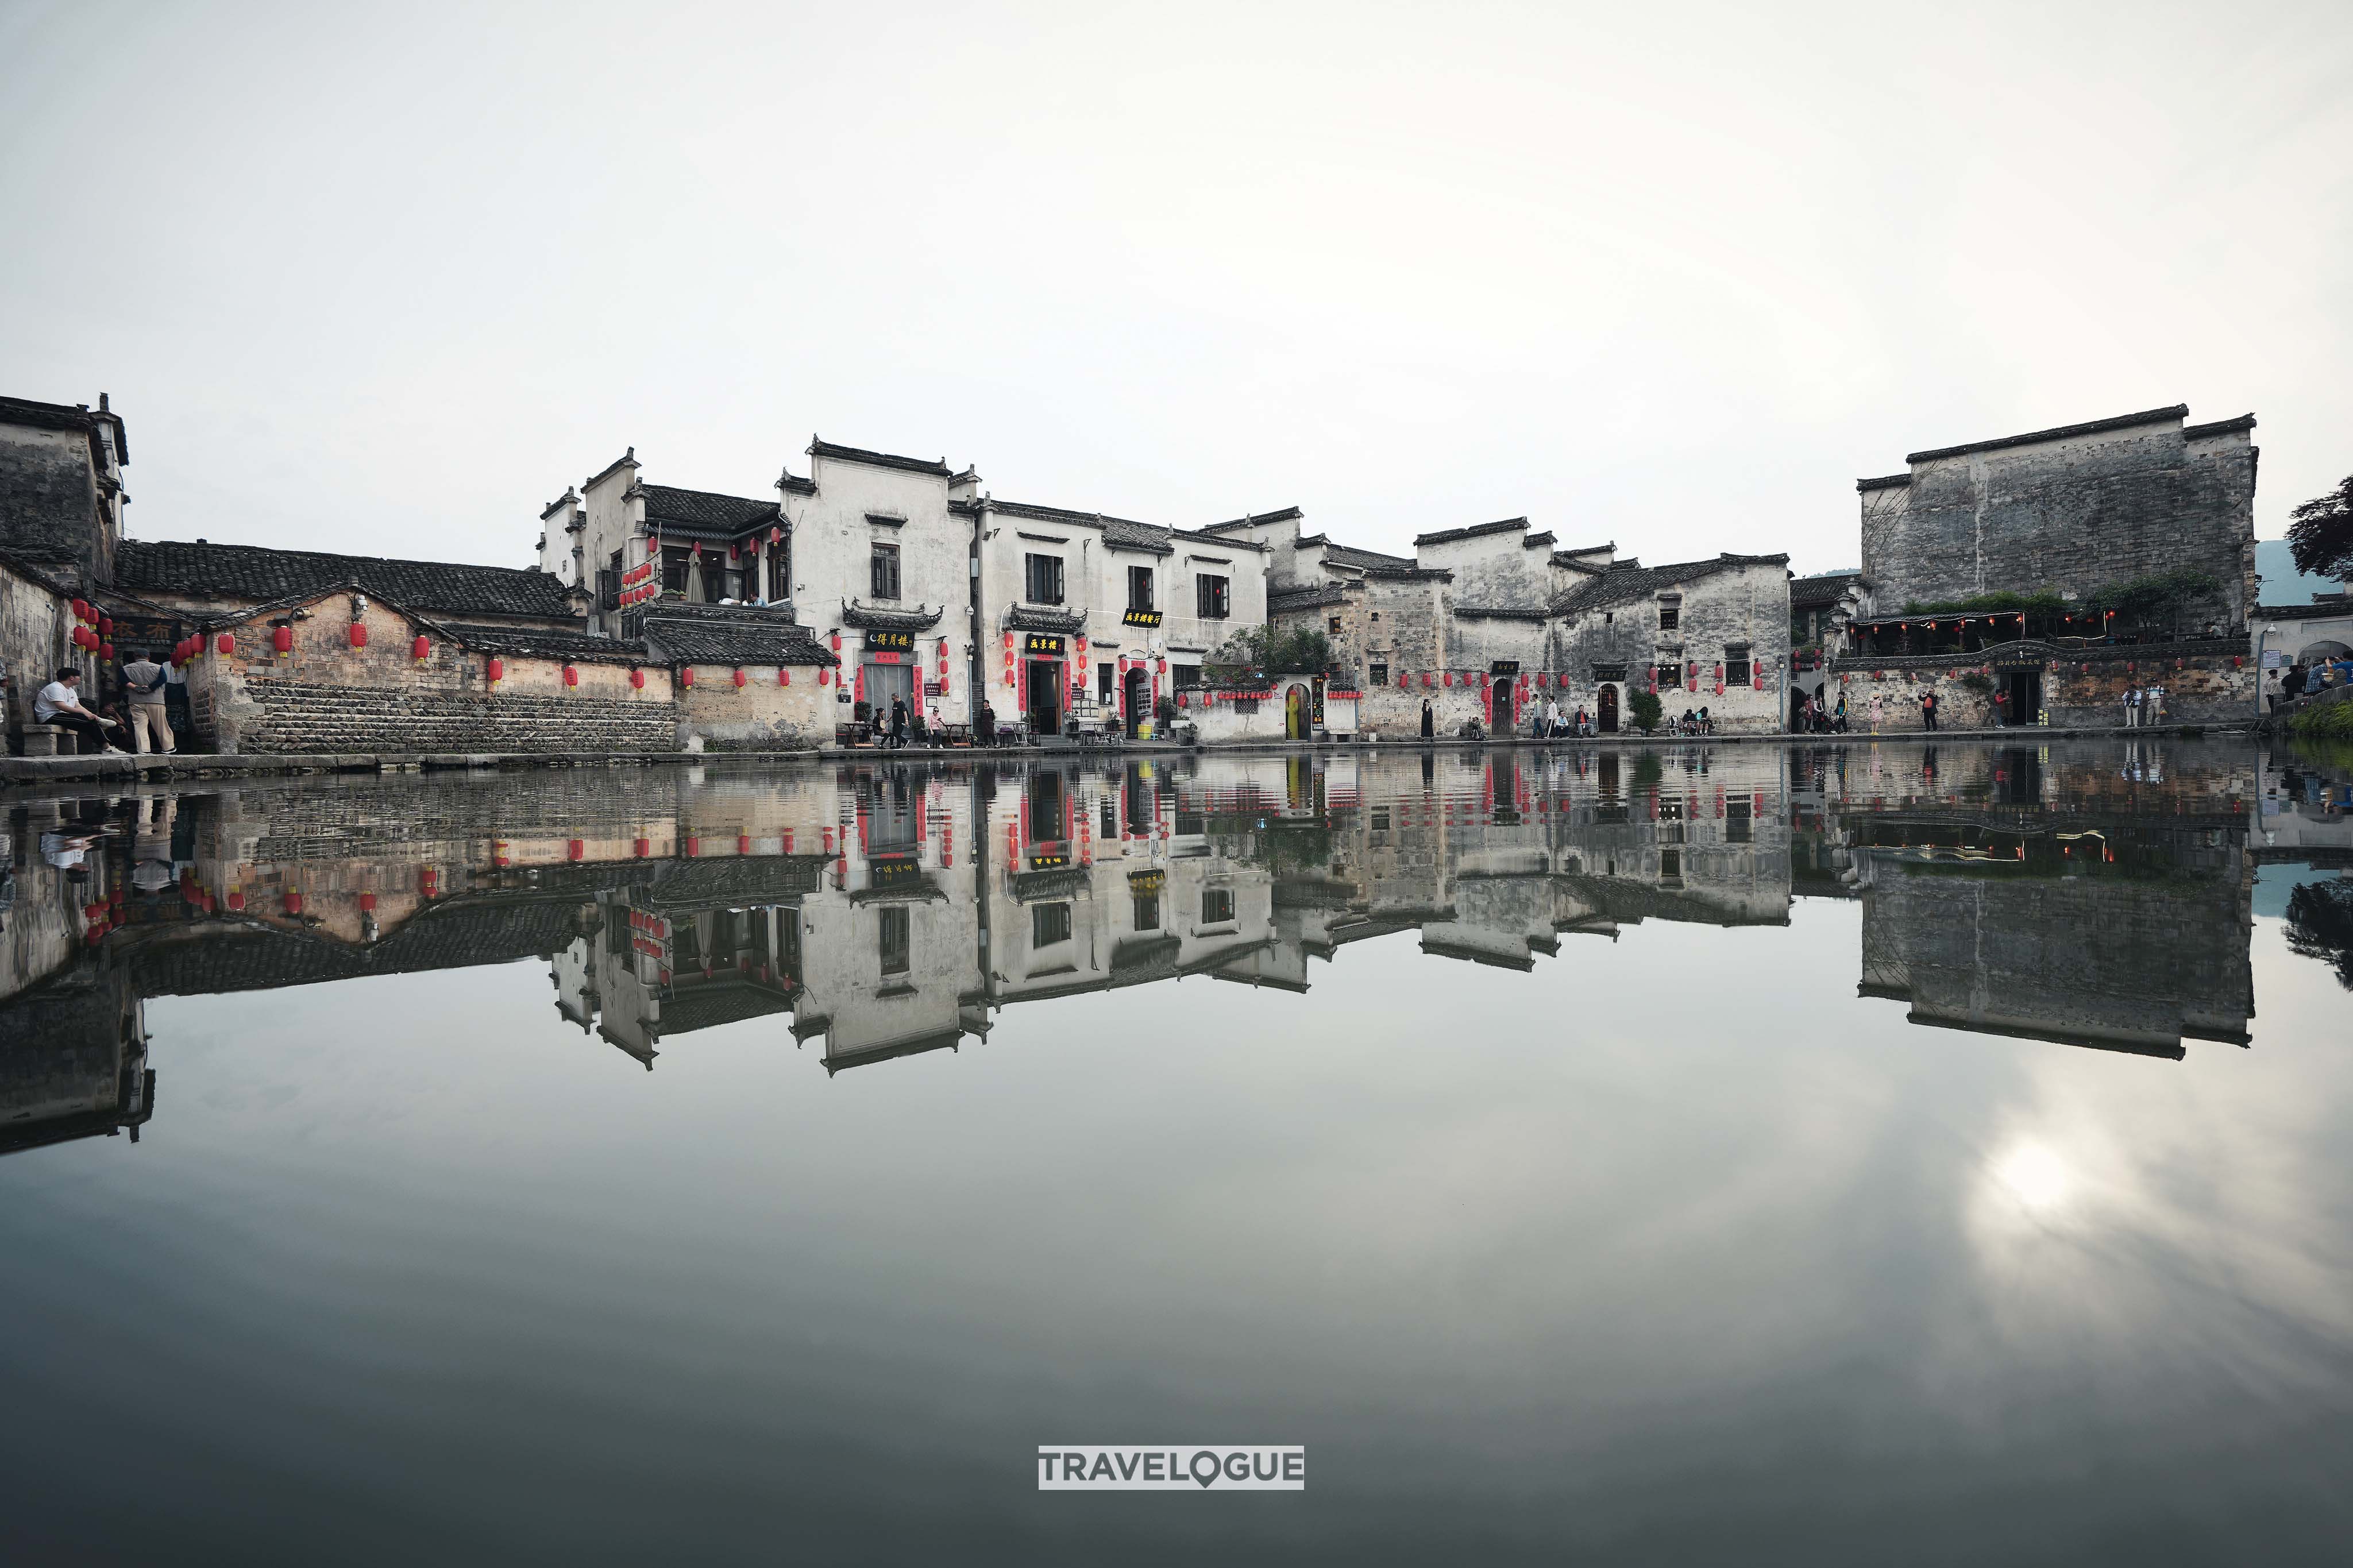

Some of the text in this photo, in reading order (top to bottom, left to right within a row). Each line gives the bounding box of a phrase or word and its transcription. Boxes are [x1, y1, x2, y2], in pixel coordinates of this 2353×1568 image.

[1126, 613, 1160, 624] 画景楼餐厅
[877, 633, 908, 646] 得月楼
[1031, 639, 1057, 650] 画景楼
